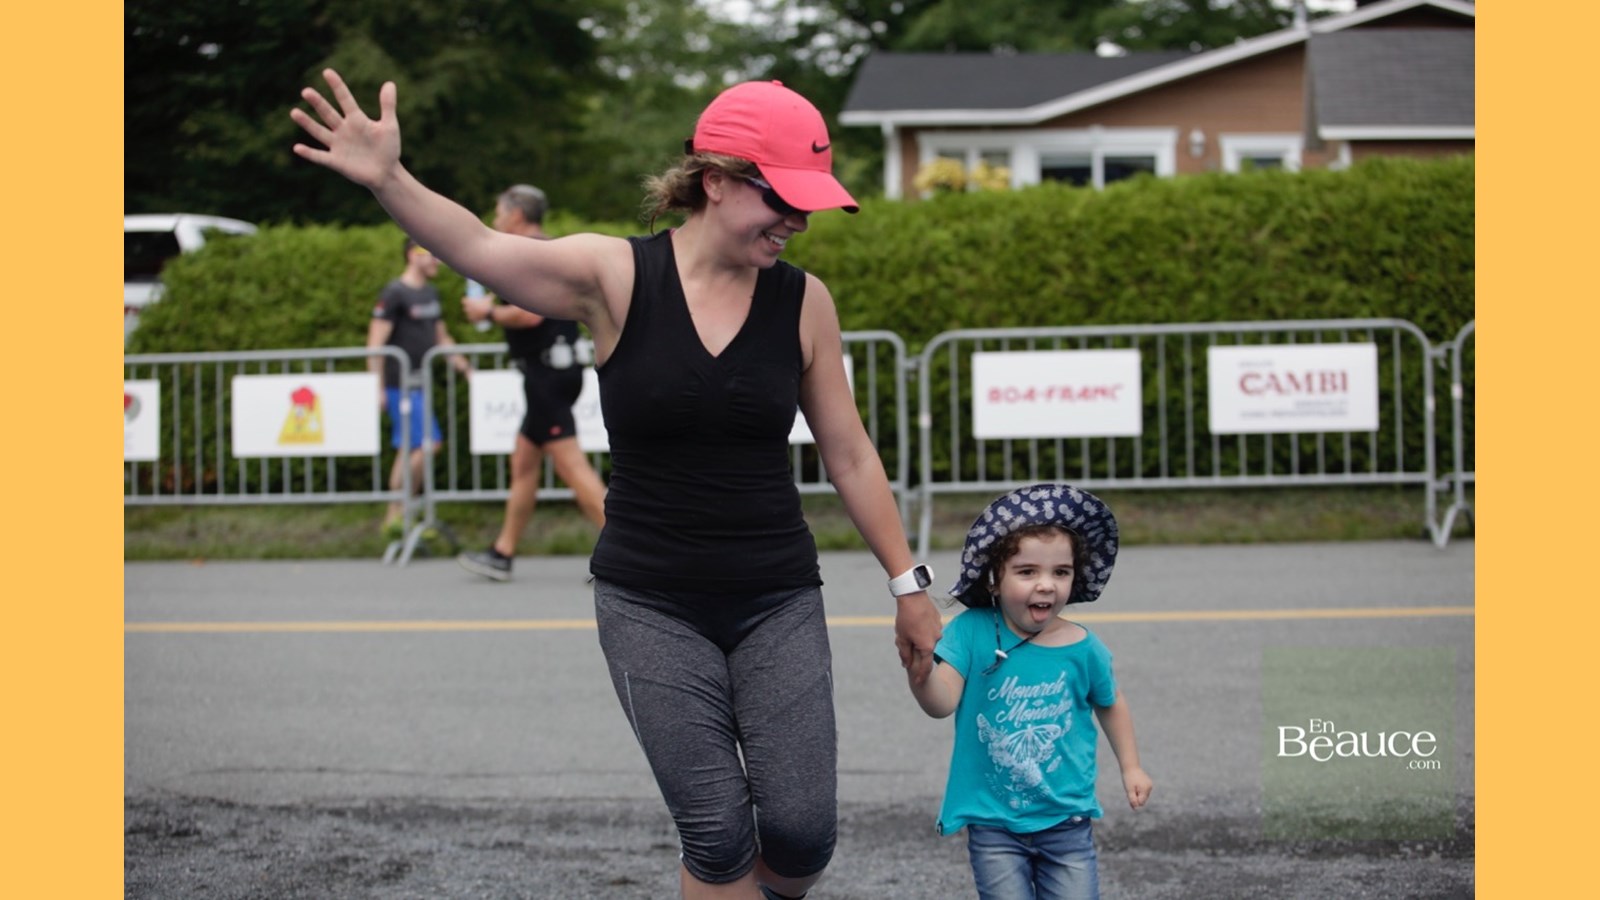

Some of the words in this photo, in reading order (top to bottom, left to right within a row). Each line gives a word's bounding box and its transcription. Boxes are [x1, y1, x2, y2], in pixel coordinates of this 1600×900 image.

[987, 383, 1124, 404] BOA-FRANC
[1238, 369, 1349, 396] CAMBI
[987, 670, 1066, 706] Monarch
